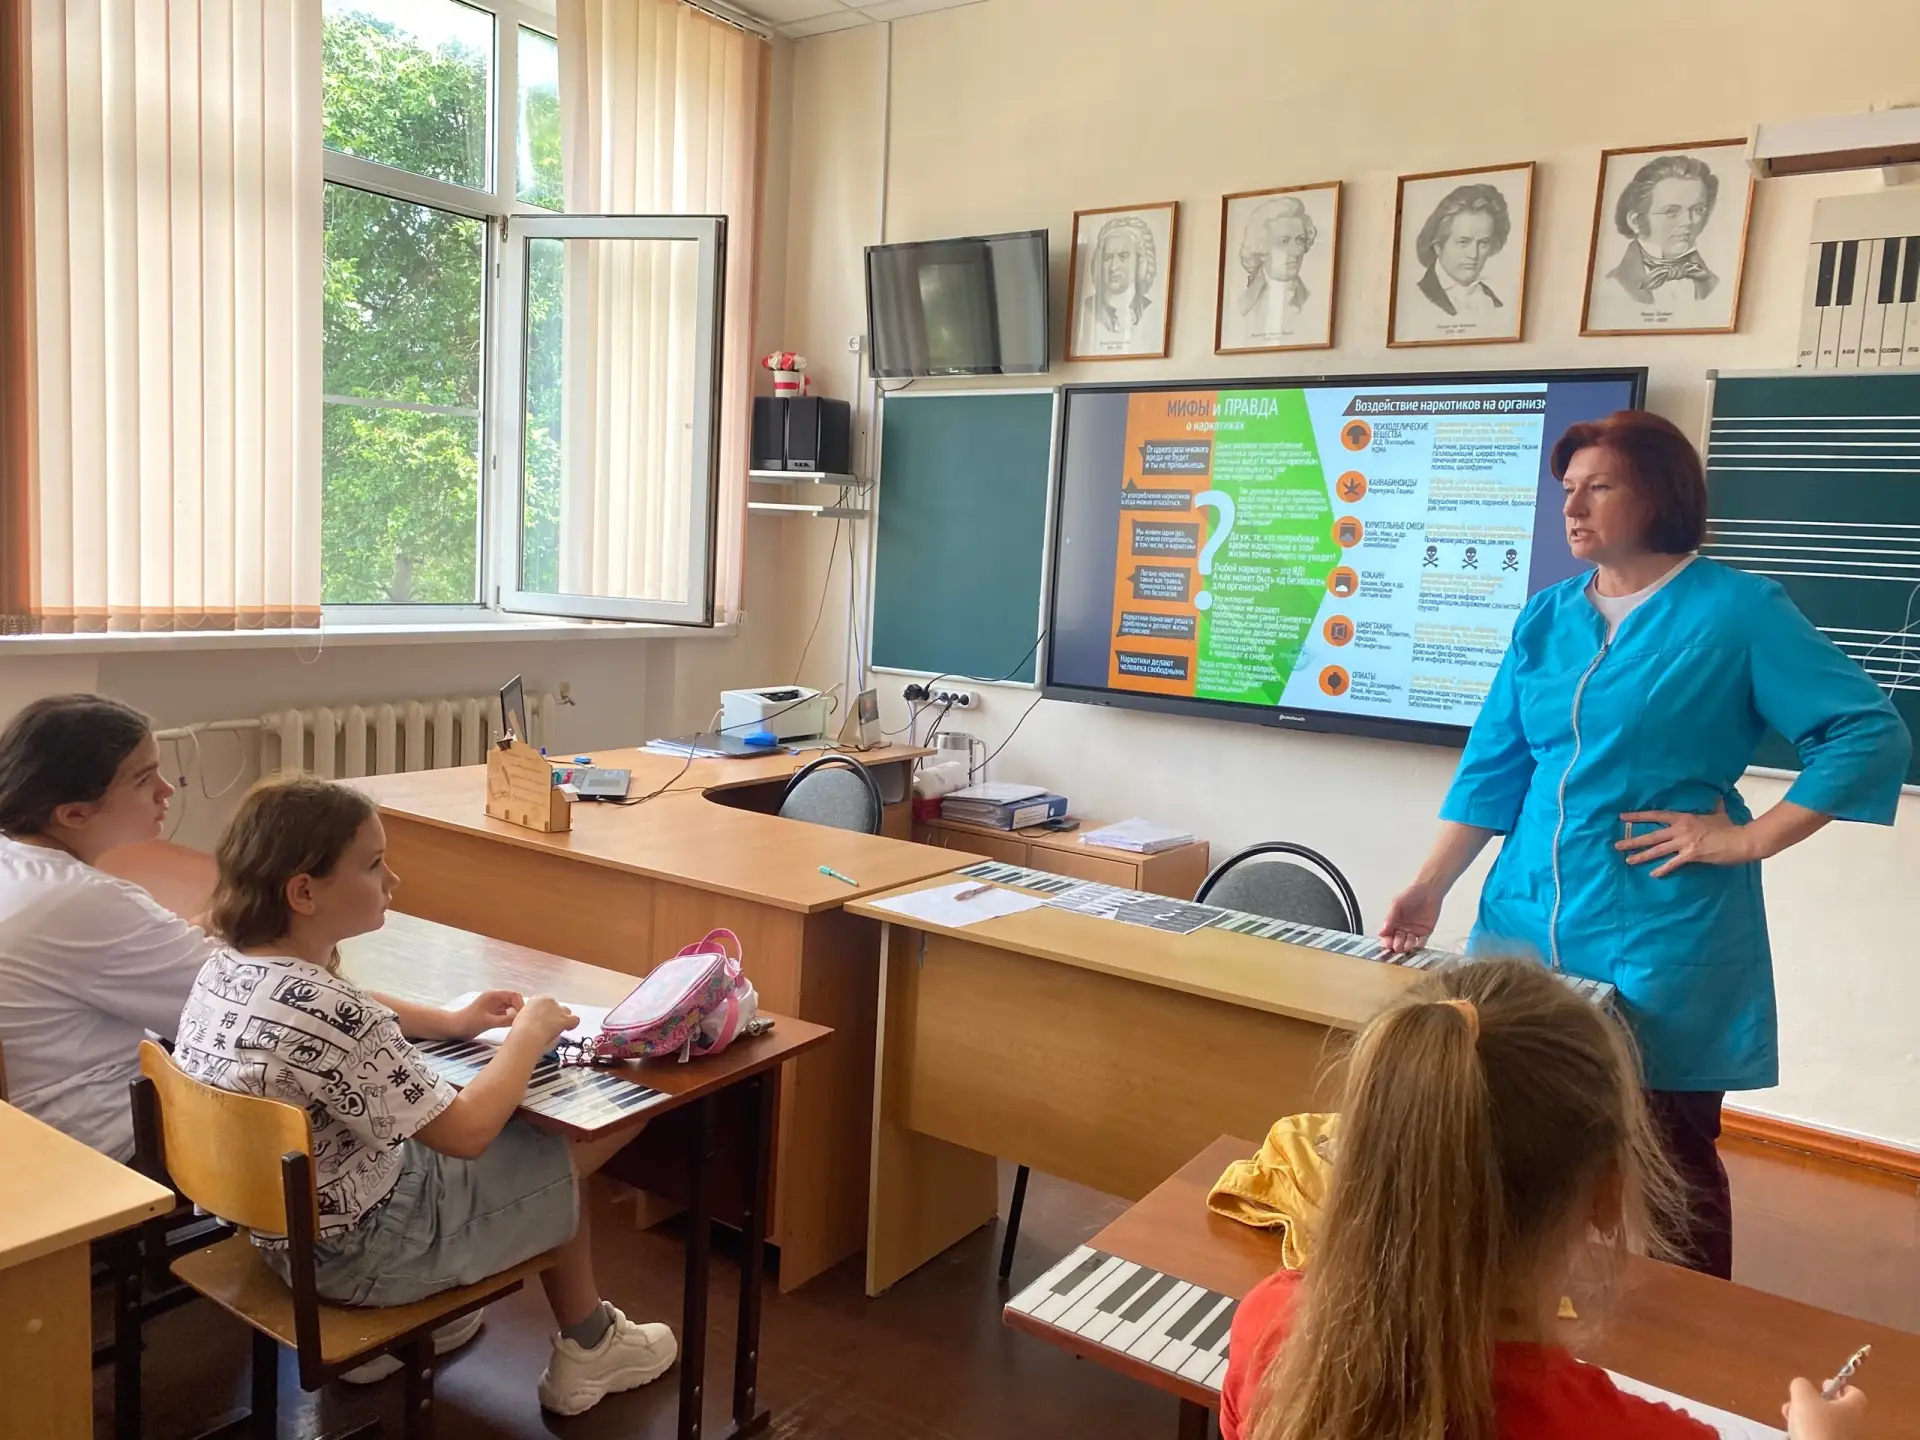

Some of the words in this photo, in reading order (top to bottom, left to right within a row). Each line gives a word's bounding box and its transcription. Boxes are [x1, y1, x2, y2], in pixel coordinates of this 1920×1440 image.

[1168, 399, 1209, 417] МИФЫ
[1212, 404, 1220, 415] и
[1224, 398, 1278, 419] ПРАВДА
[1356, 398, 1418, 413] Воздействие
[1420, 400, 1480, 413] наркотиков
[1194, 421, 1245, 432] наркотиках
[1214, 562, 1237, 573] Любой
[1121, 655, 1150, 667] Наркотики
